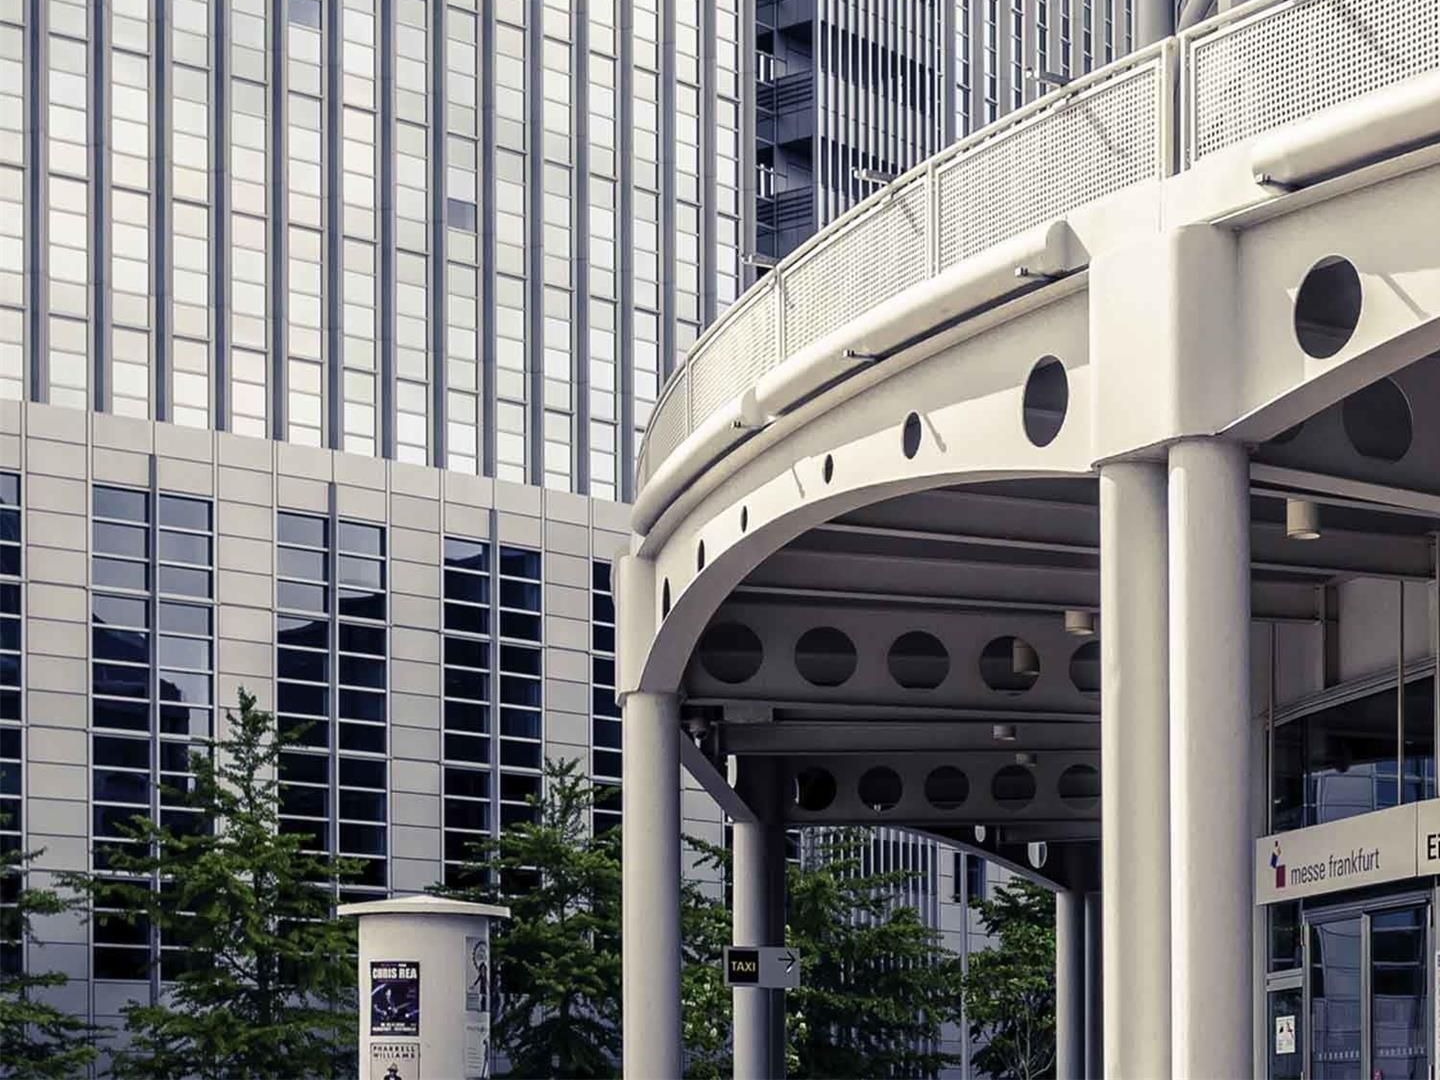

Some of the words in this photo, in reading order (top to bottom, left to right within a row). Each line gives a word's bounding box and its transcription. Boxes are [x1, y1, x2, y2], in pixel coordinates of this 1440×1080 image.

[1290, 859, 1326, 886] messe
[1329, 848, 1380, 879] frankfurt
[731, 961, 756, 973] TAXI
